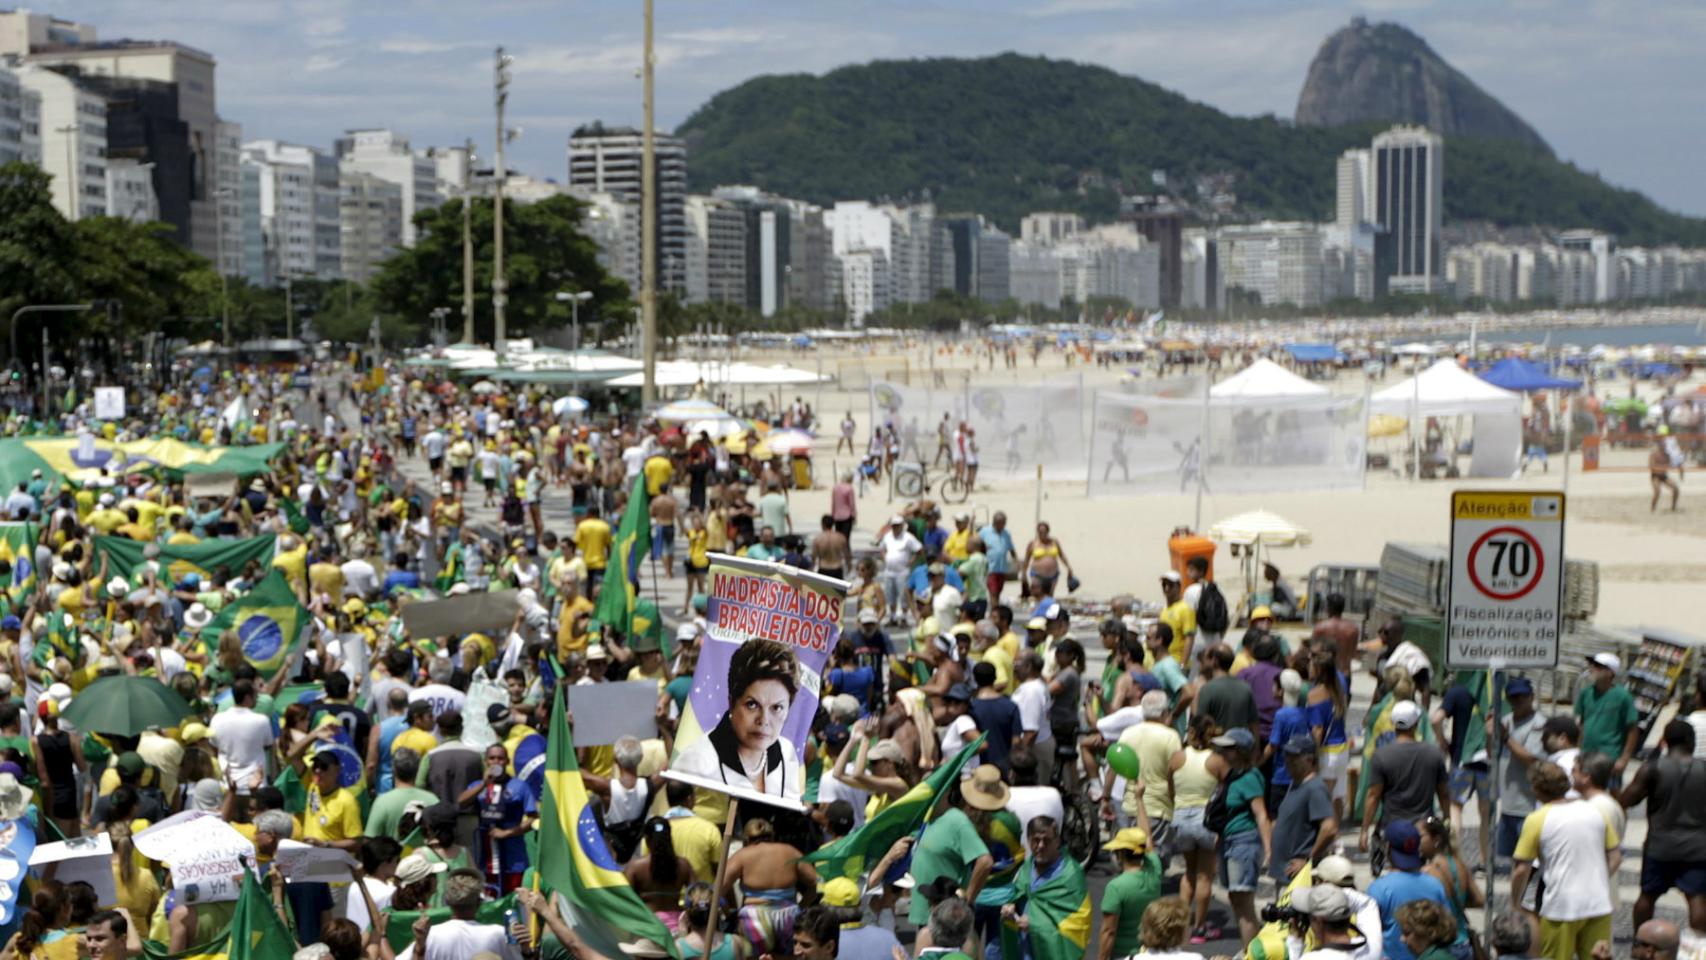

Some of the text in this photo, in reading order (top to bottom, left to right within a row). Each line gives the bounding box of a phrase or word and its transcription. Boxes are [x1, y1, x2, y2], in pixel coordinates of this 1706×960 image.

[1458, 501, 1528, 516] Atenção
[1487, 541, 1531, 577] 70
[713, 573, 841, 623] MADRASTA DOS
[1454, 606, 1553, 622] Fiscalização
[718, 603, 831, 651] BRASILEIROS!
[1451, 624, 1555, 638] Eletrônica de
[1459, 643, 1548, 657] Velocidade
